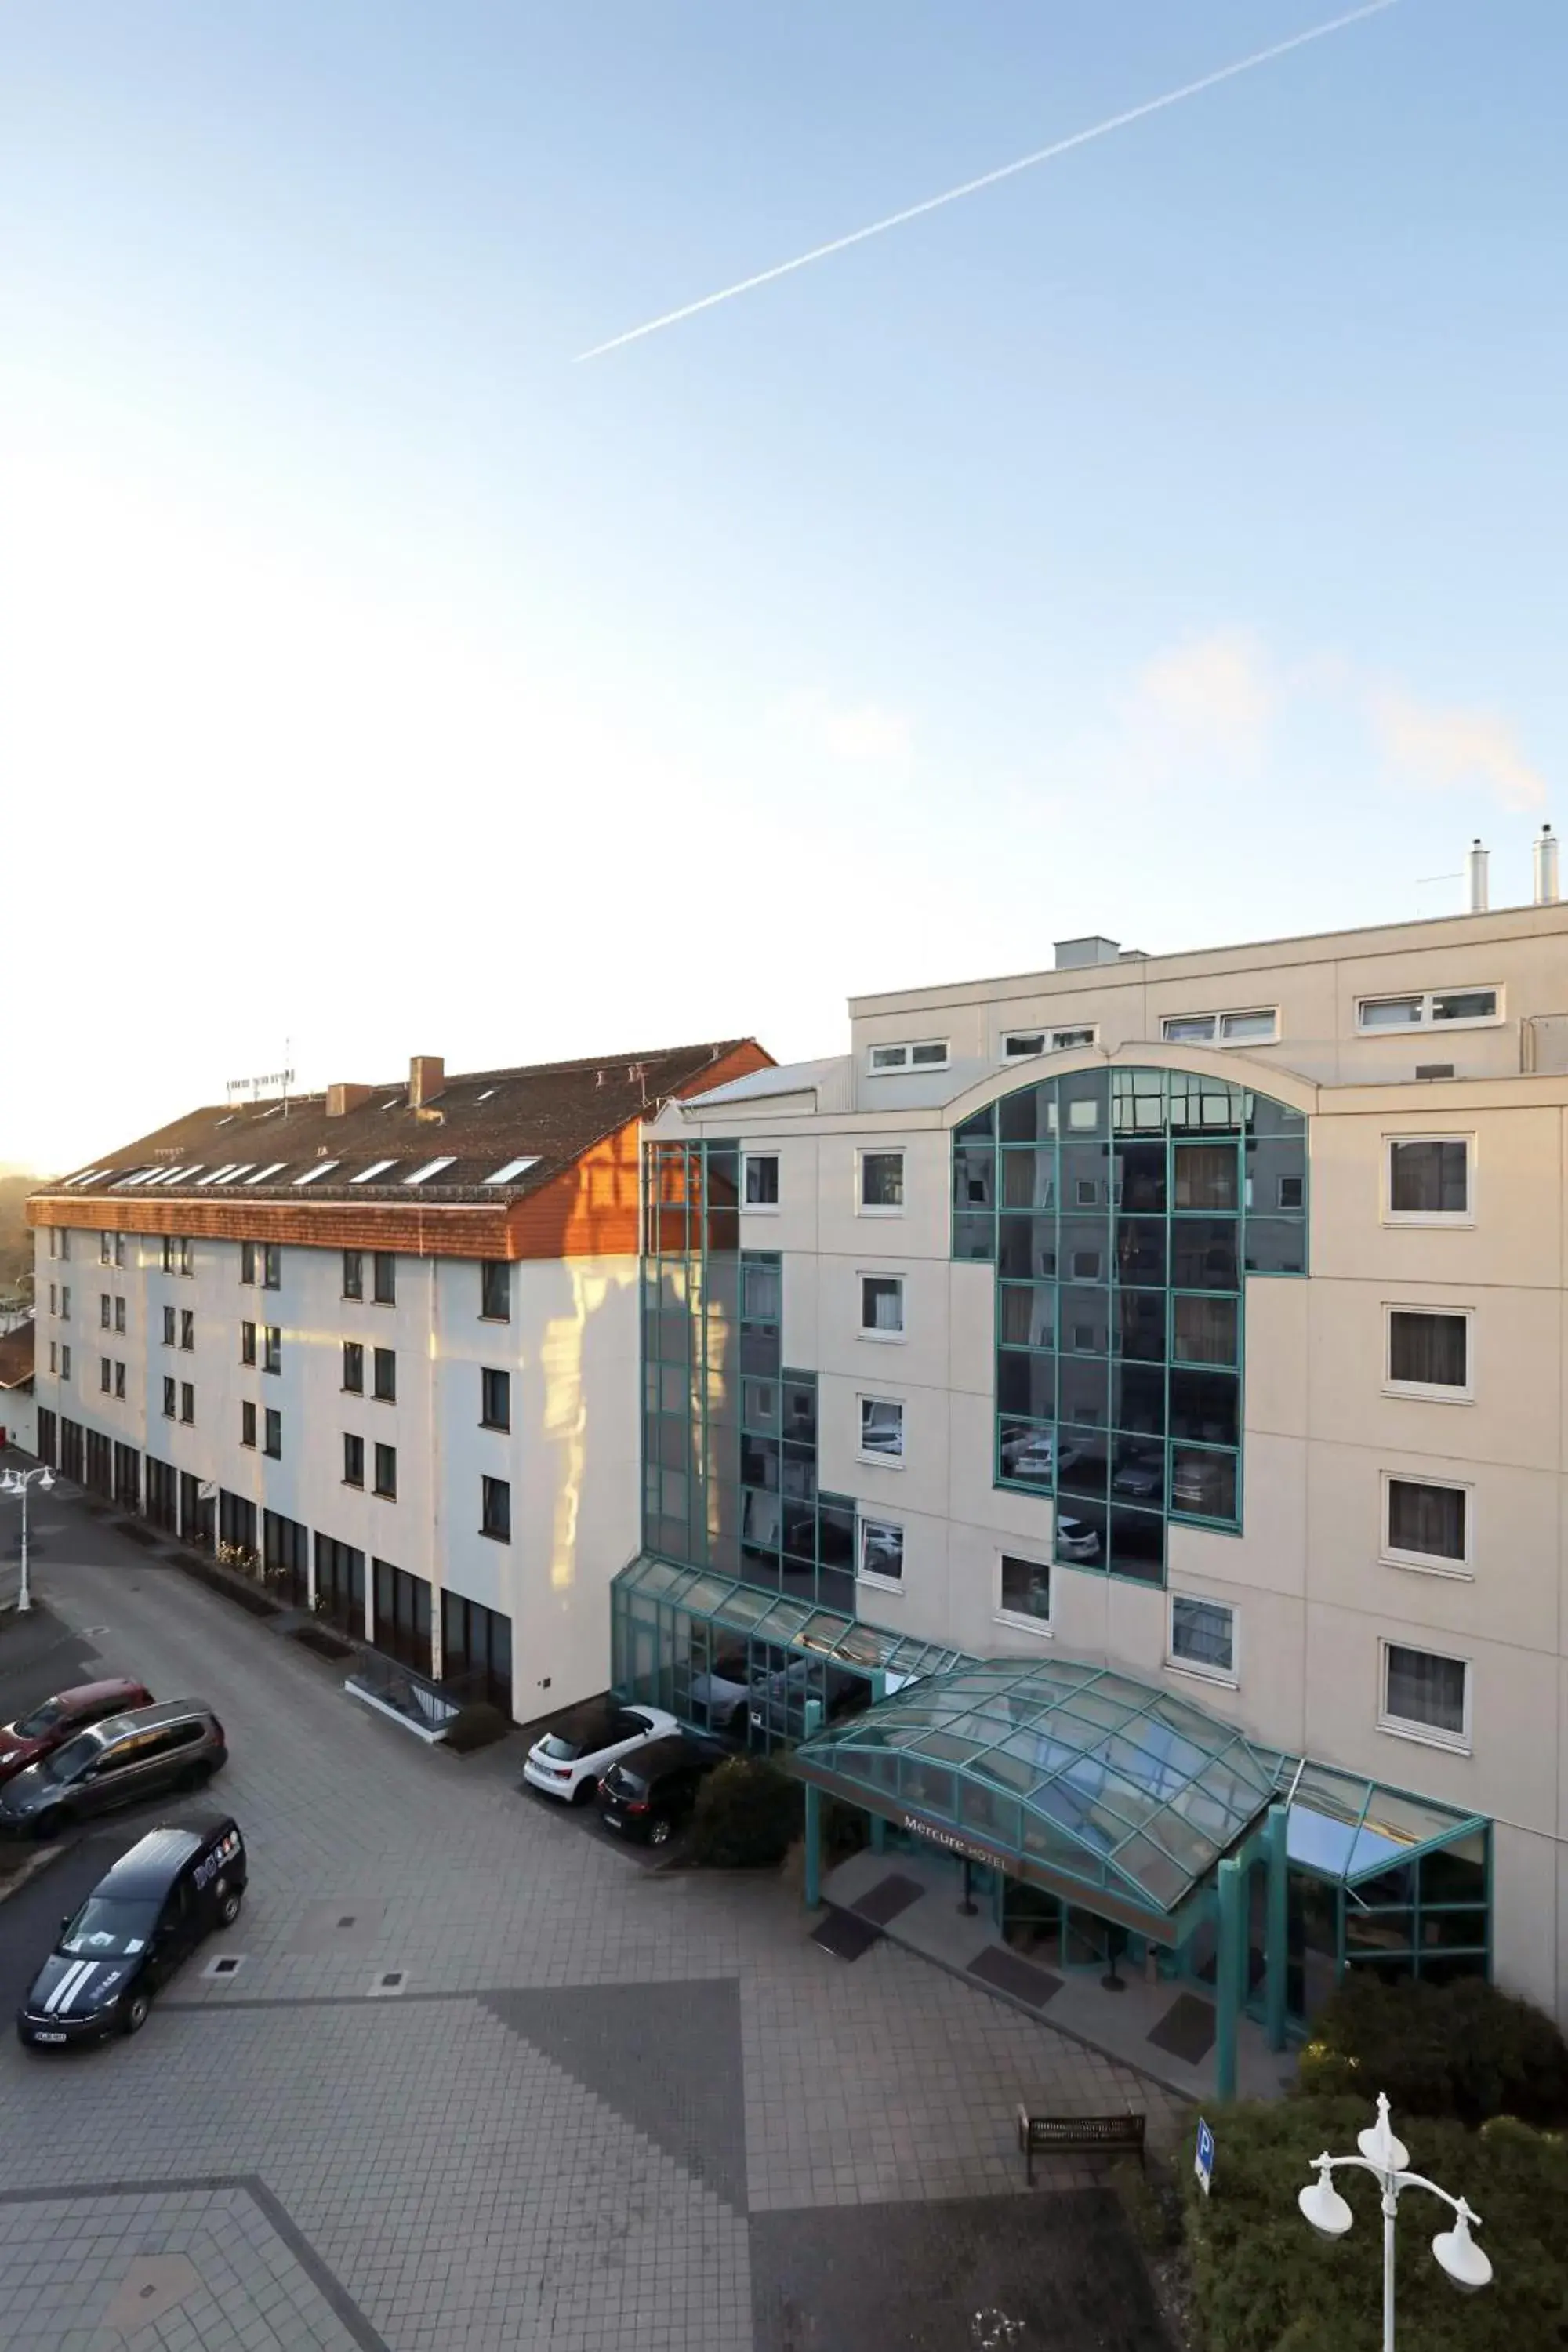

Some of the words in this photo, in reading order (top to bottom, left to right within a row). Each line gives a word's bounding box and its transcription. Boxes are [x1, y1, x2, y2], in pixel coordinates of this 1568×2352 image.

[904, 1815, 964, 1851] Mercure
[967, 1846, 1006, 1870] HOTEL
[1200, 2129, 1210, 2155] P
